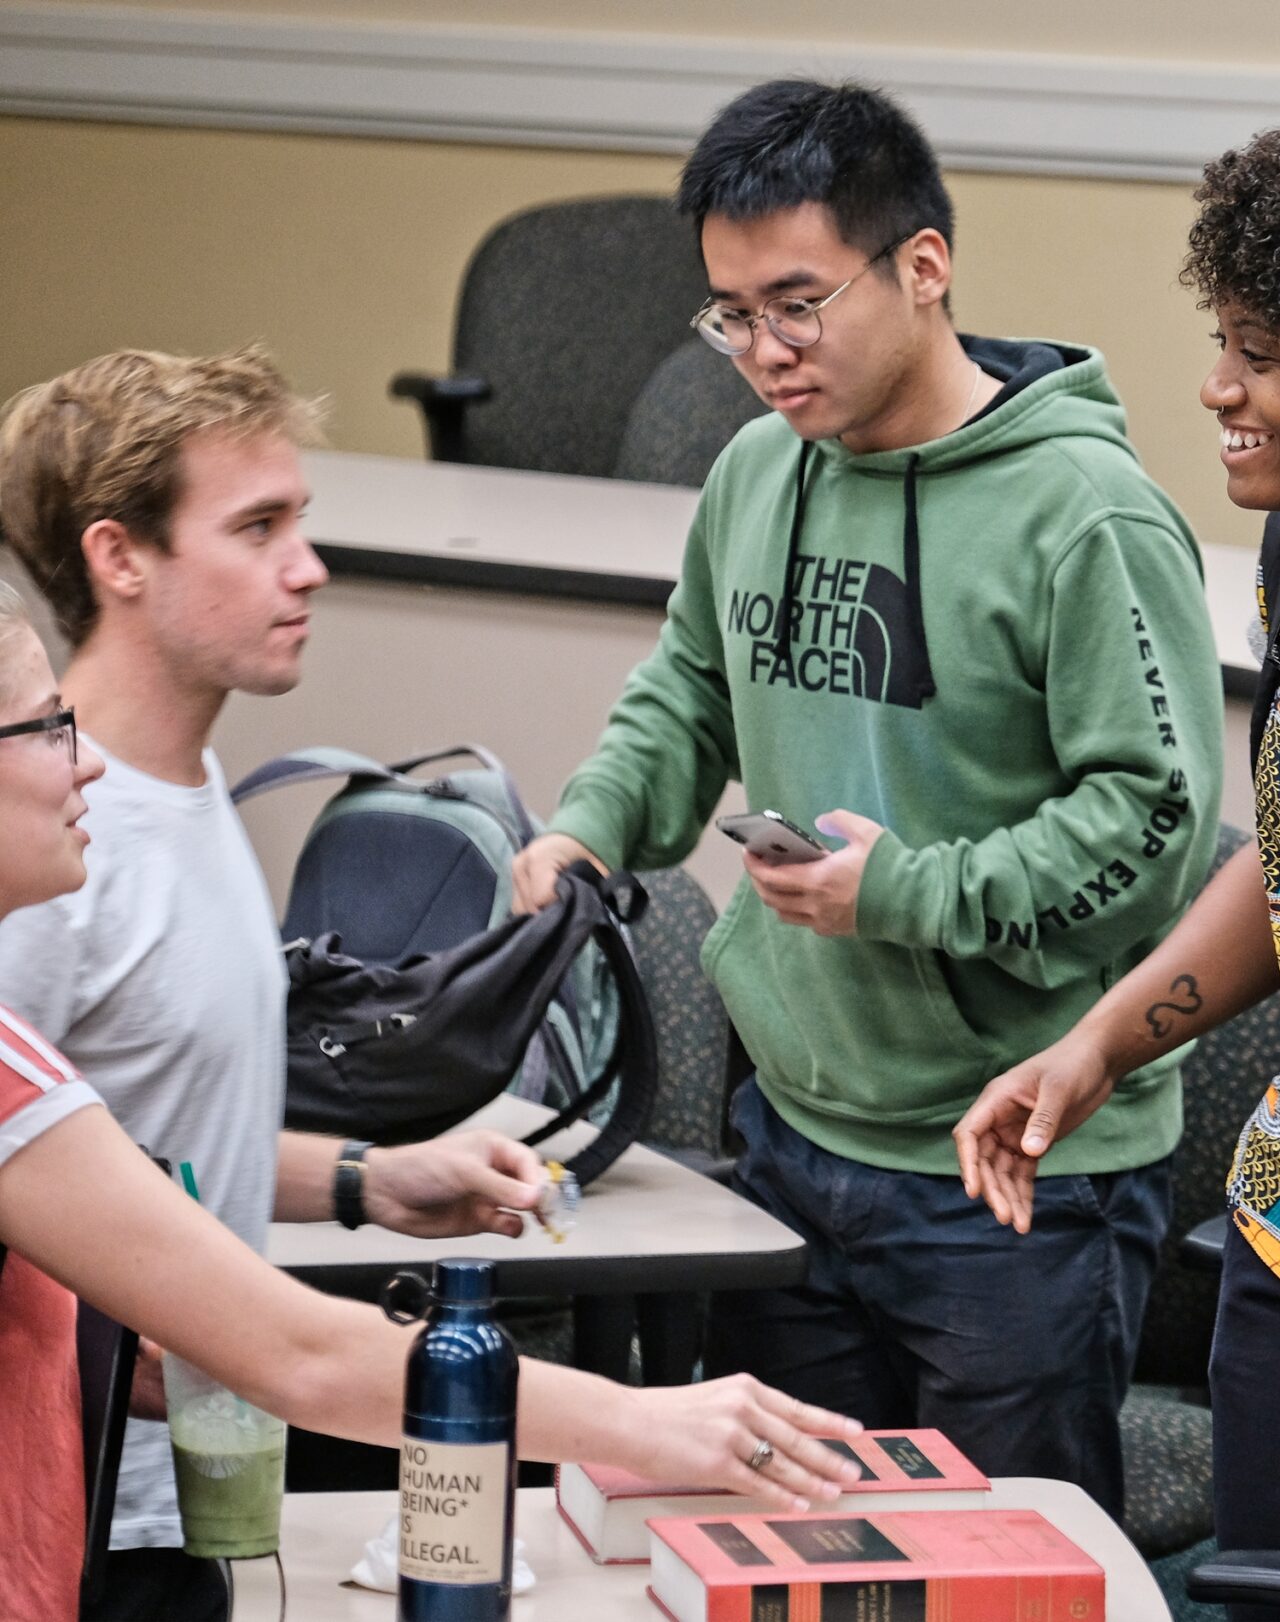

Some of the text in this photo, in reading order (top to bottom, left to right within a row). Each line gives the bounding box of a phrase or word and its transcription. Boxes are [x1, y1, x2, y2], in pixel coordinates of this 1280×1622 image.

[792, 554, 867, 603] THE
[728, 589, 856, 650] NORTH
[750, 640, 851, 695] FACE
[1129, 606, 1176, 748] NEVER
[1141, 768, 1189, 859] STOP
[404, 1444, 427, 1466] NO
[402, 1468, 481, 1493] HUMAN
[401, 1513, 412, 1534] IS
[401, 1536, 480, 1565] ILLEGAL.
